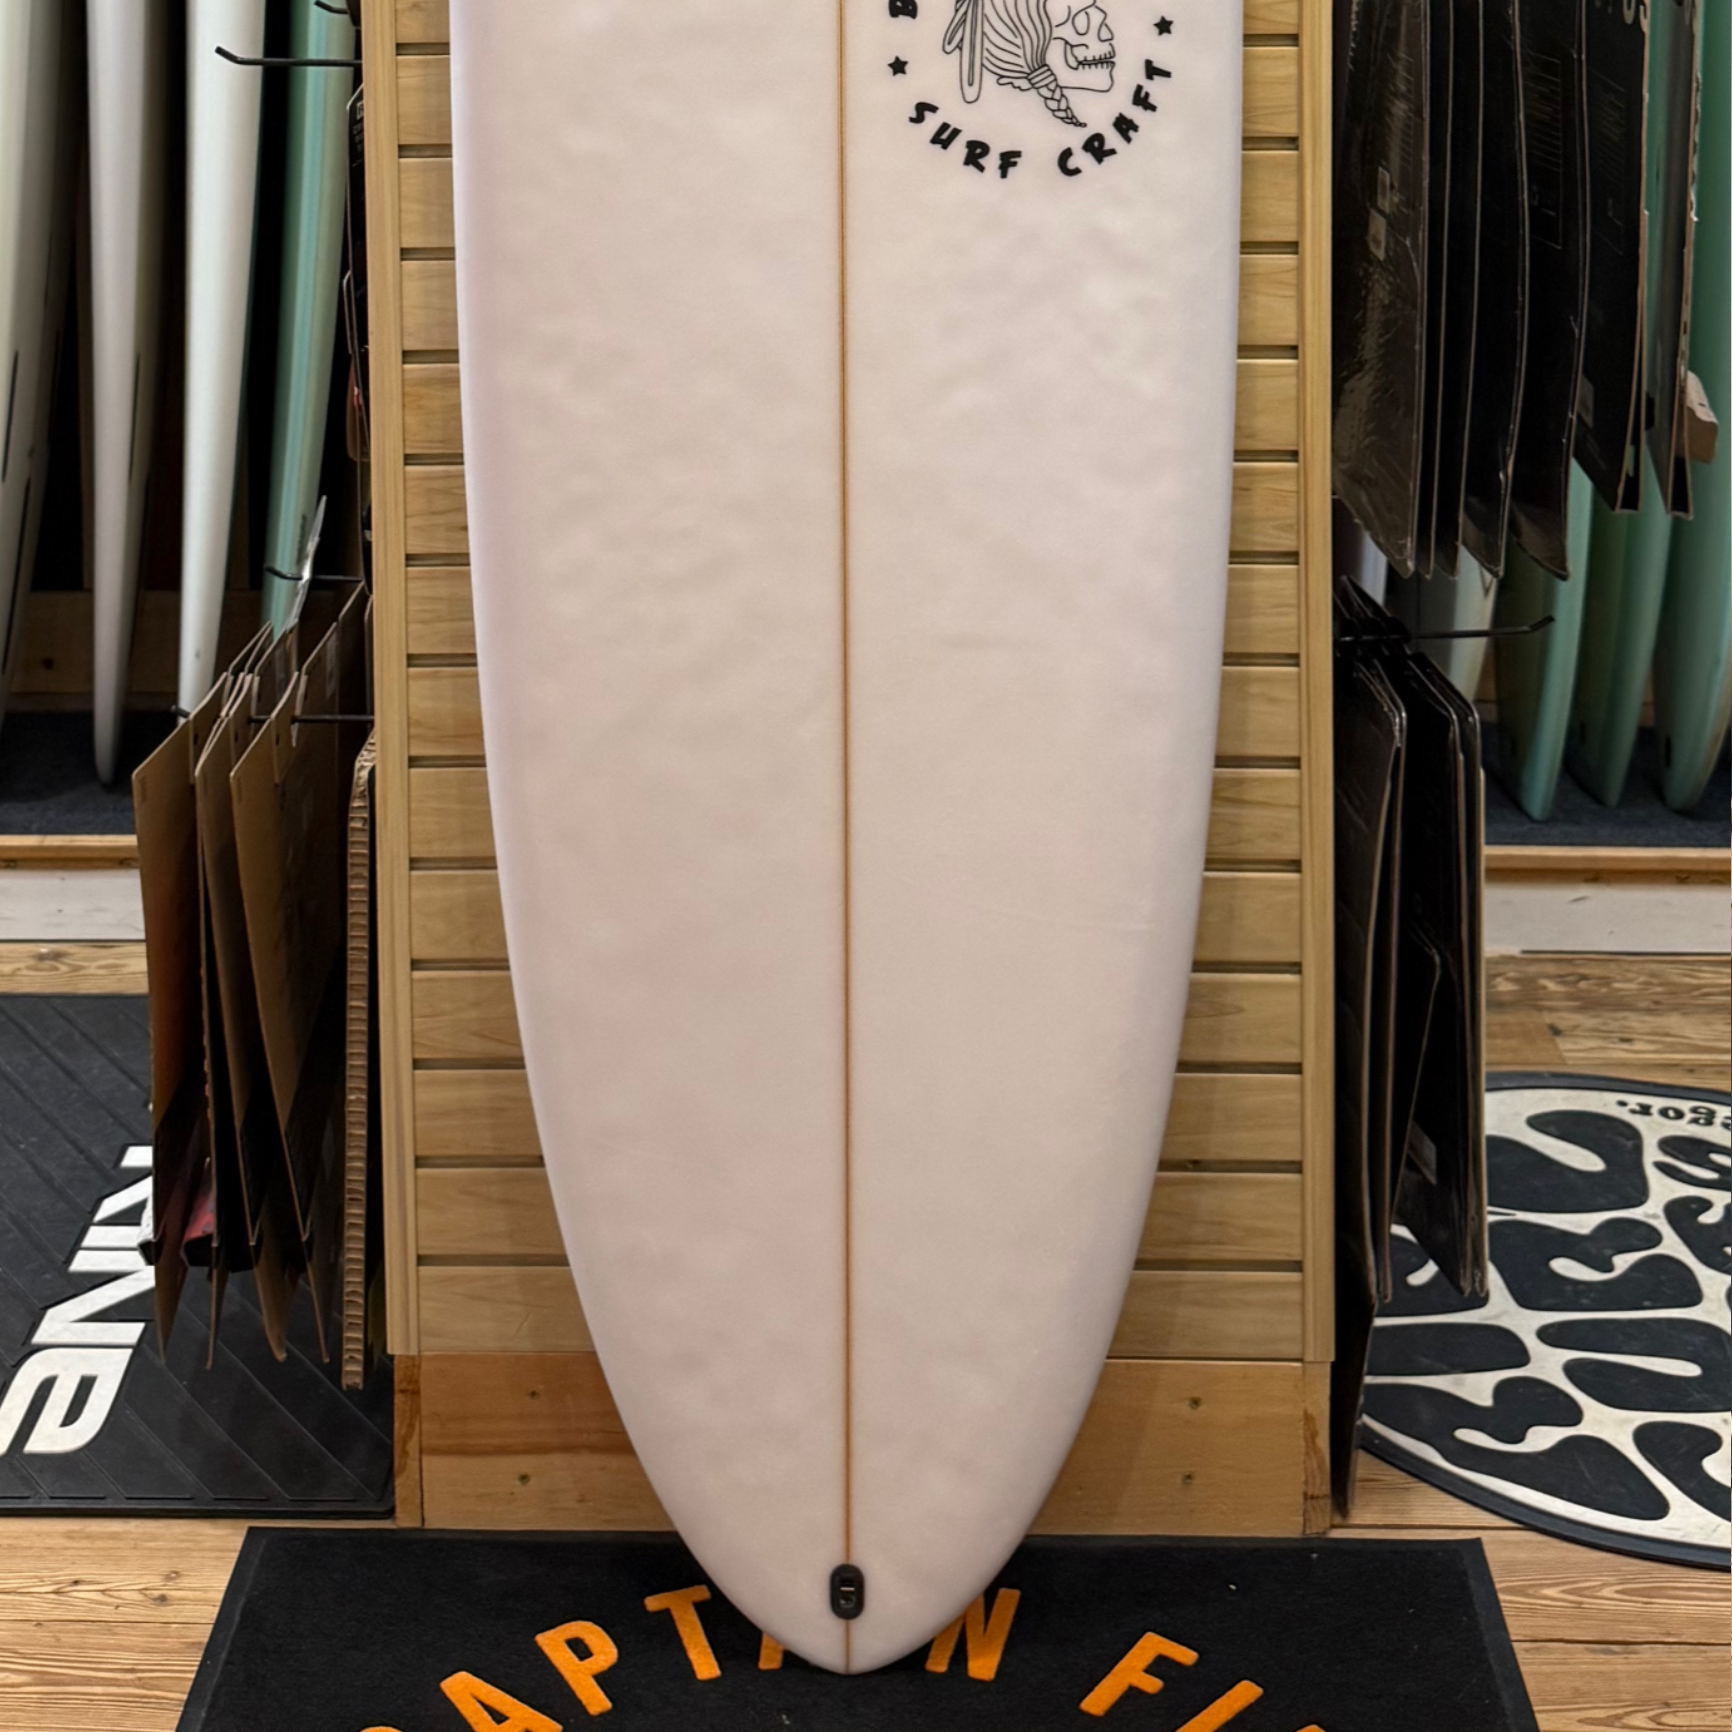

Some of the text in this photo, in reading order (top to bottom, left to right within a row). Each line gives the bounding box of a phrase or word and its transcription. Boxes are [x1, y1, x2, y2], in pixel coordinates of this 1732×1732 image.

[908, 59, 1172, 179] SURF CRAFT
[1079, 1631, 1330, 1732] FI
